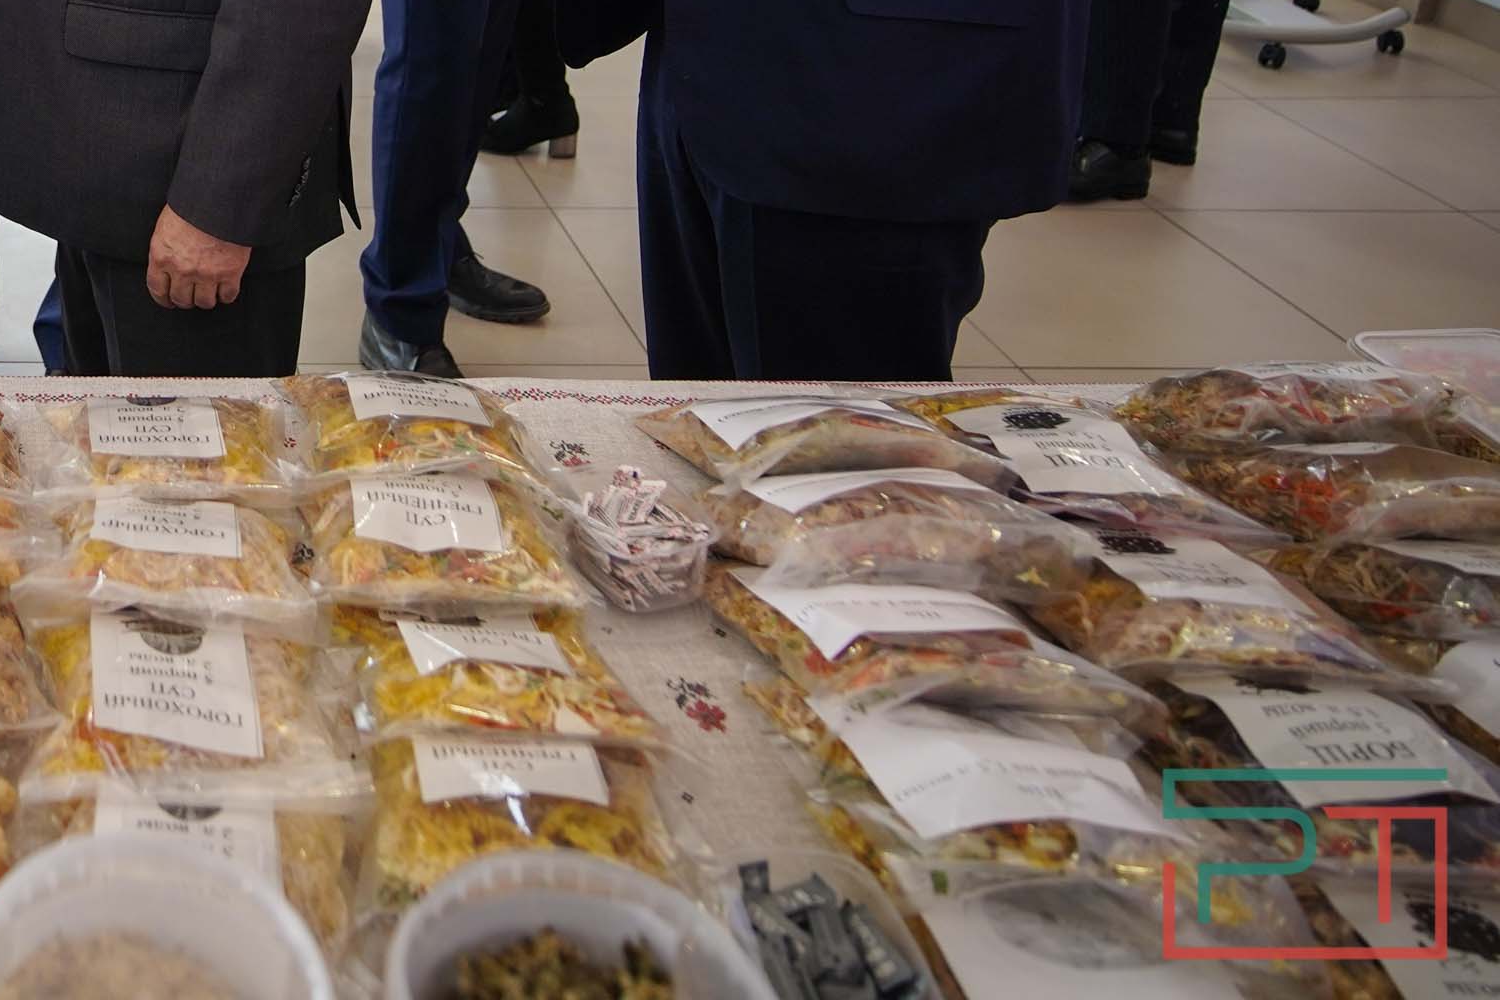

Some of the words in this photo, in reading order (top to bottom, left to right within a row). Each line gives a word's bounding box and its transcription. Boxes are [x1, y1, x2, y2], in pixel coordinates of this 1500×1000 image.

[135, 424, 172, 434] СУП
[366, 490, 483, 516] ГРЕЧНЕВЫЙ
[405, 510, 447, 527] СУП
[149, 681, 196, 700] СУП
[102, 692, 245, 729] ГОРОХОВЫЙ
[1305, 741, 1417, 766] БОРЩ
